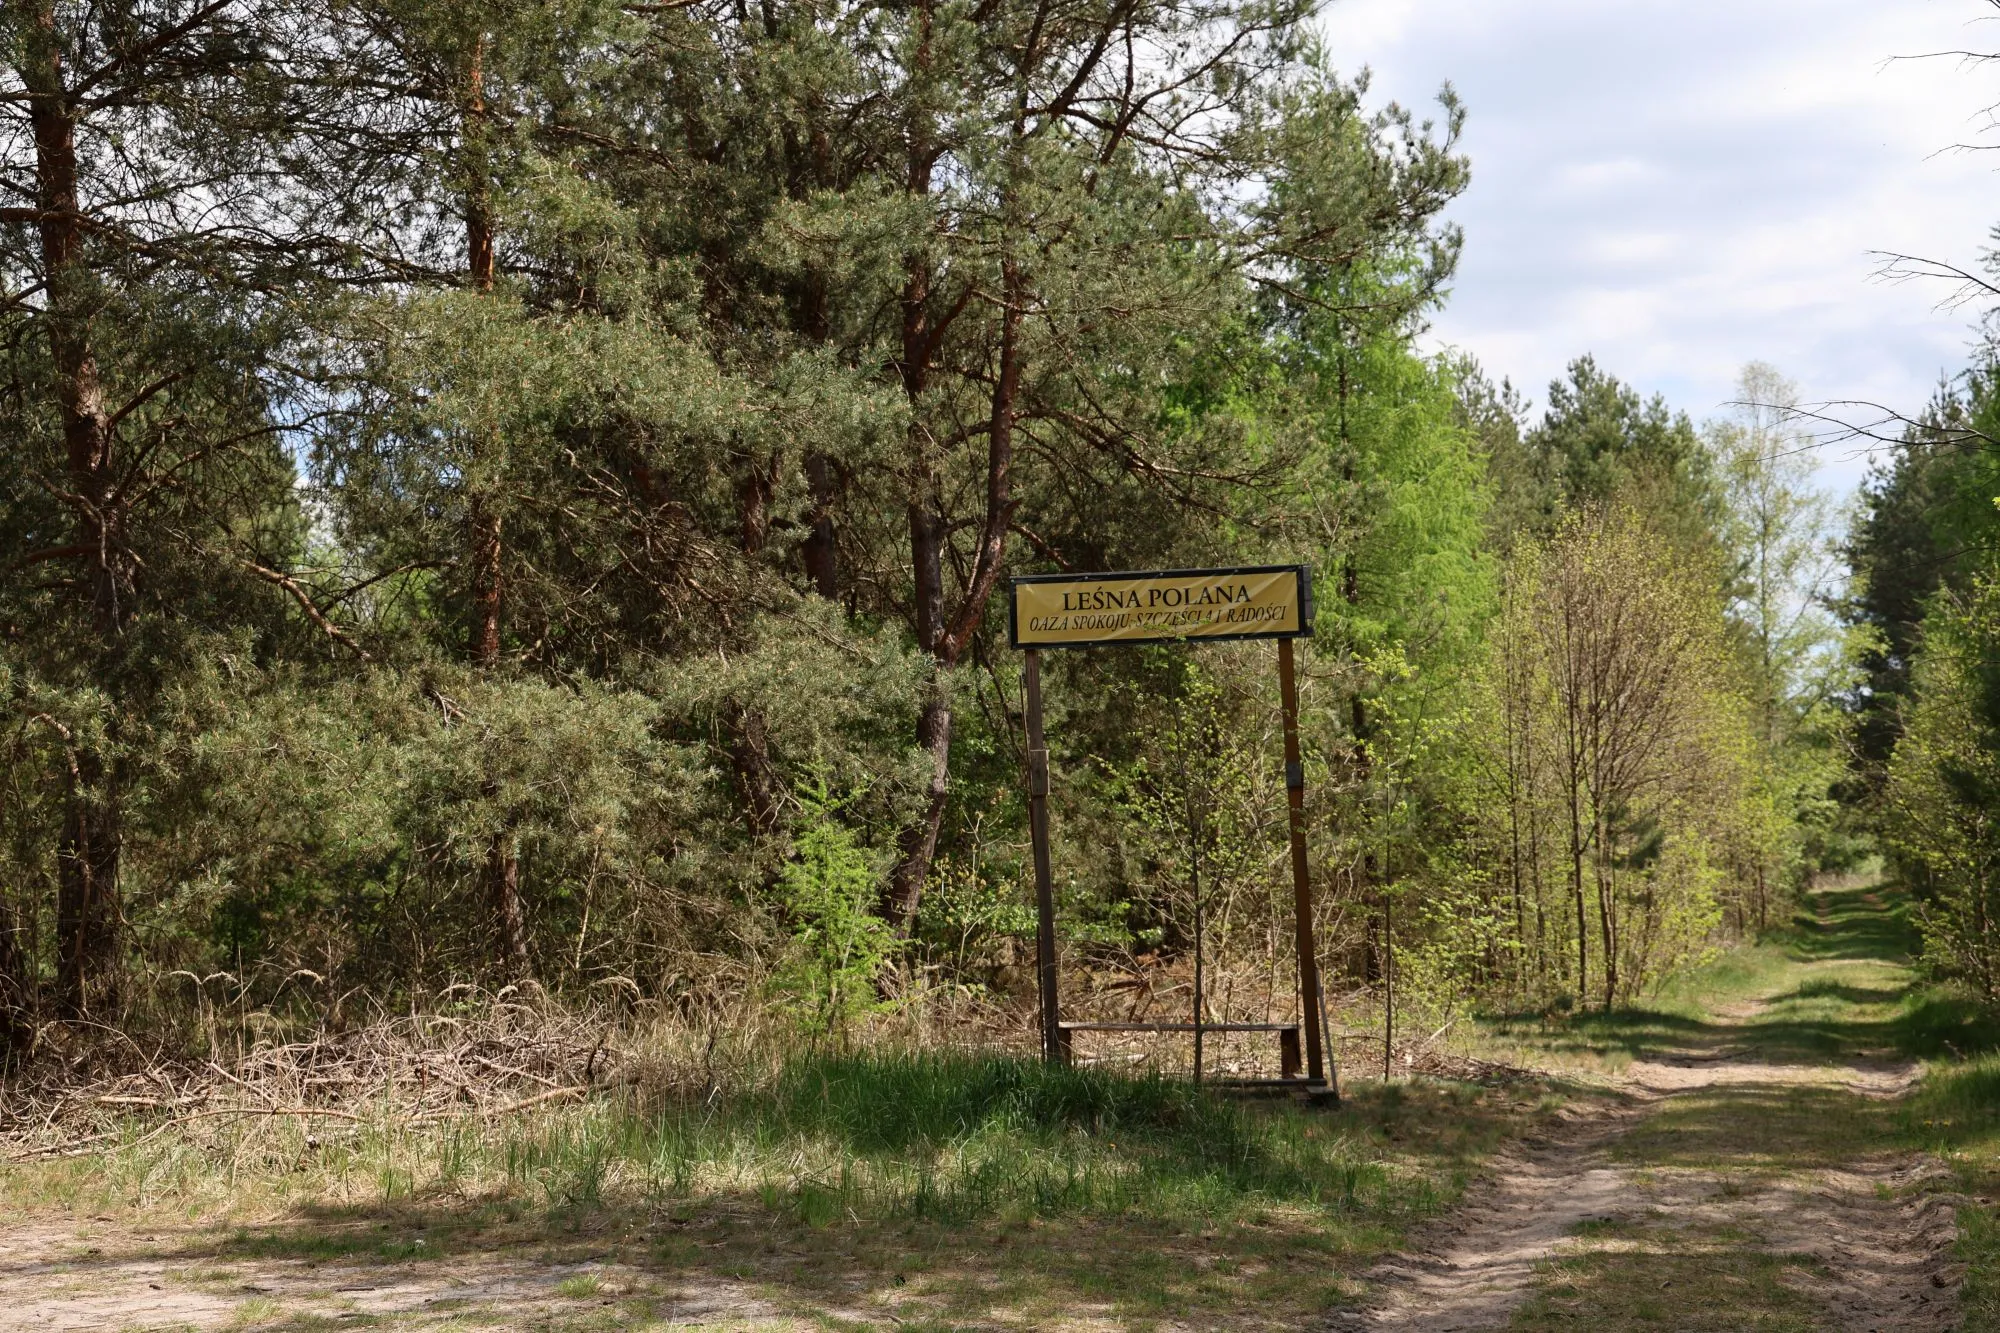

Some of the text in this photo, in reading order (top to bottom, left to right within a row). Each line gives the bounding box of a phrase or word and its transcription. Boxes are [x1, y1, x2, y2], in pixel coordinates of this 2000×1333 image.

[1063, 585, 1251, 611] LEŚNA POLANA
[1029, 616, 1068, 631] OAZA
[1215, 609, 1222, 624] I
[1226, 603, 1288, 623] RADOŚCI
